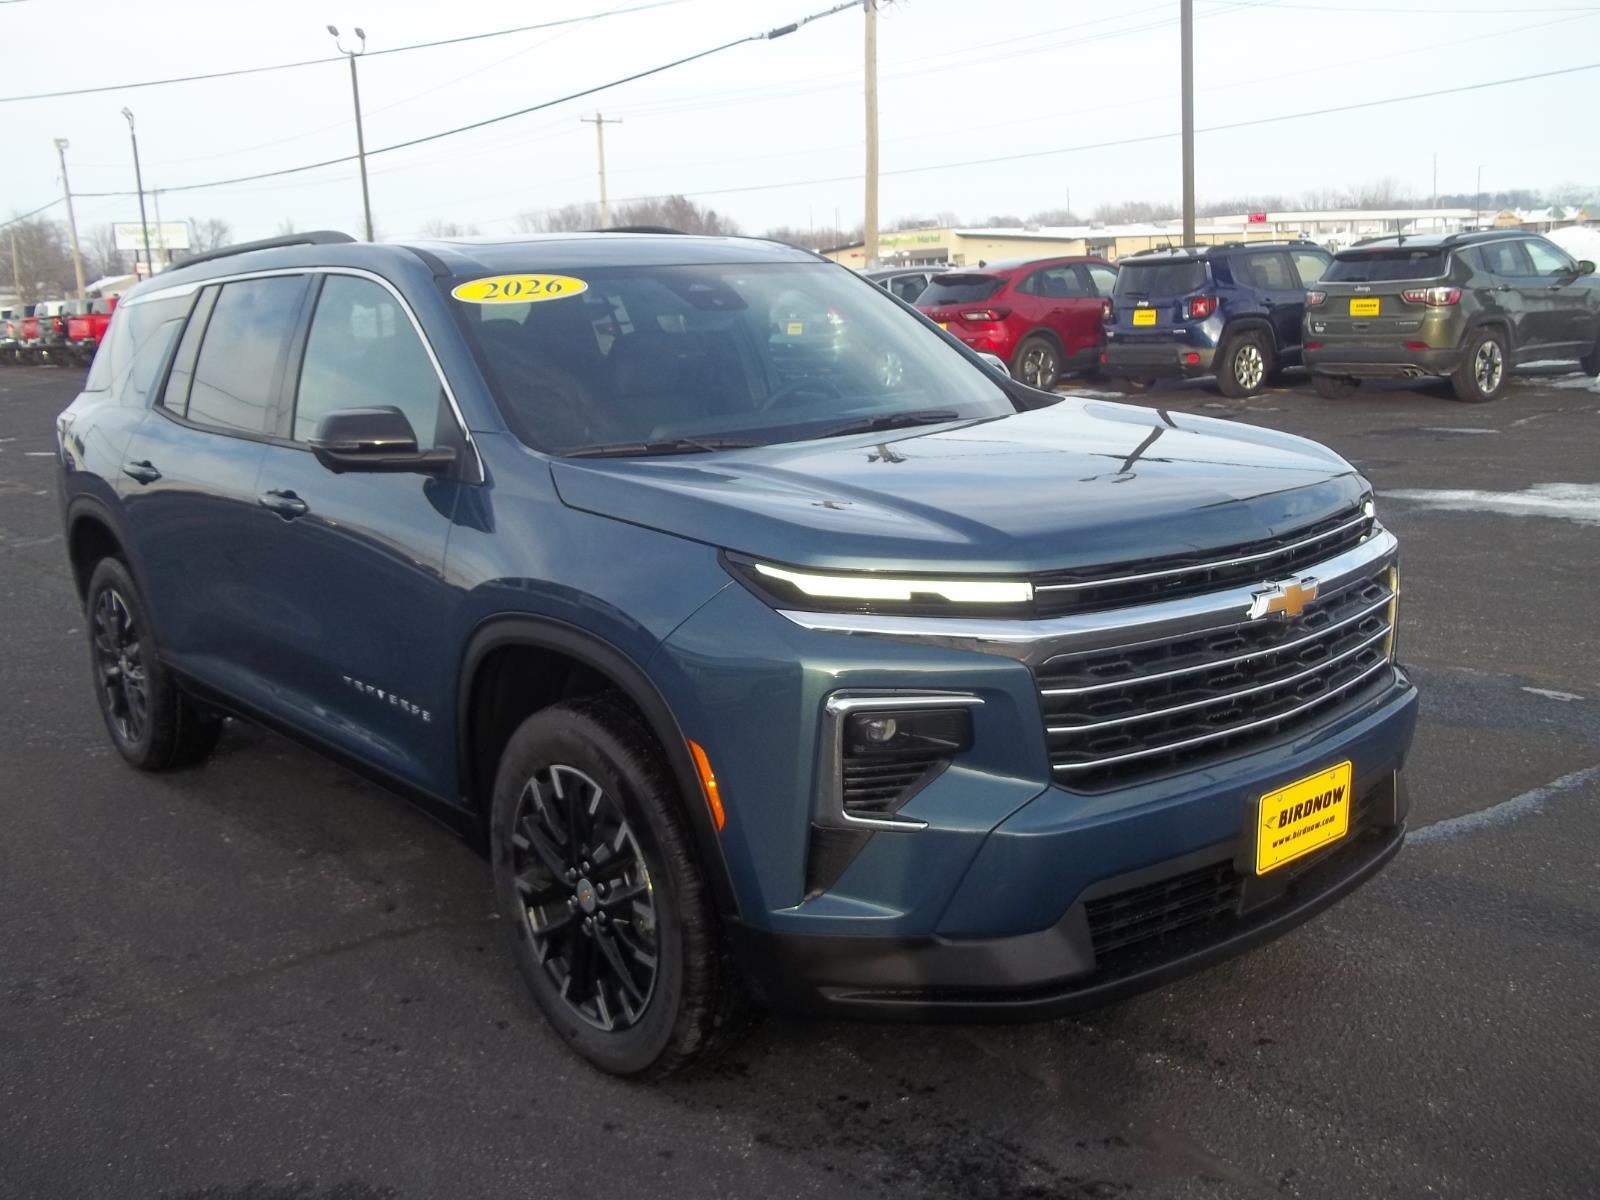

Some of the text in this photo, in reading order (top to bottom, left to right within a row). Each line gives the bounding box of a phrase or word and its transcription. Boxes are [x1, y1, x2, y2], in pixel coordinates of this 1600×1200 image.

[483, 279, 562, 299] 2026
[1278, 784, 1346, 829] BIRDNOW
[1272, 815, 1336, 849] www.birdnow.com
